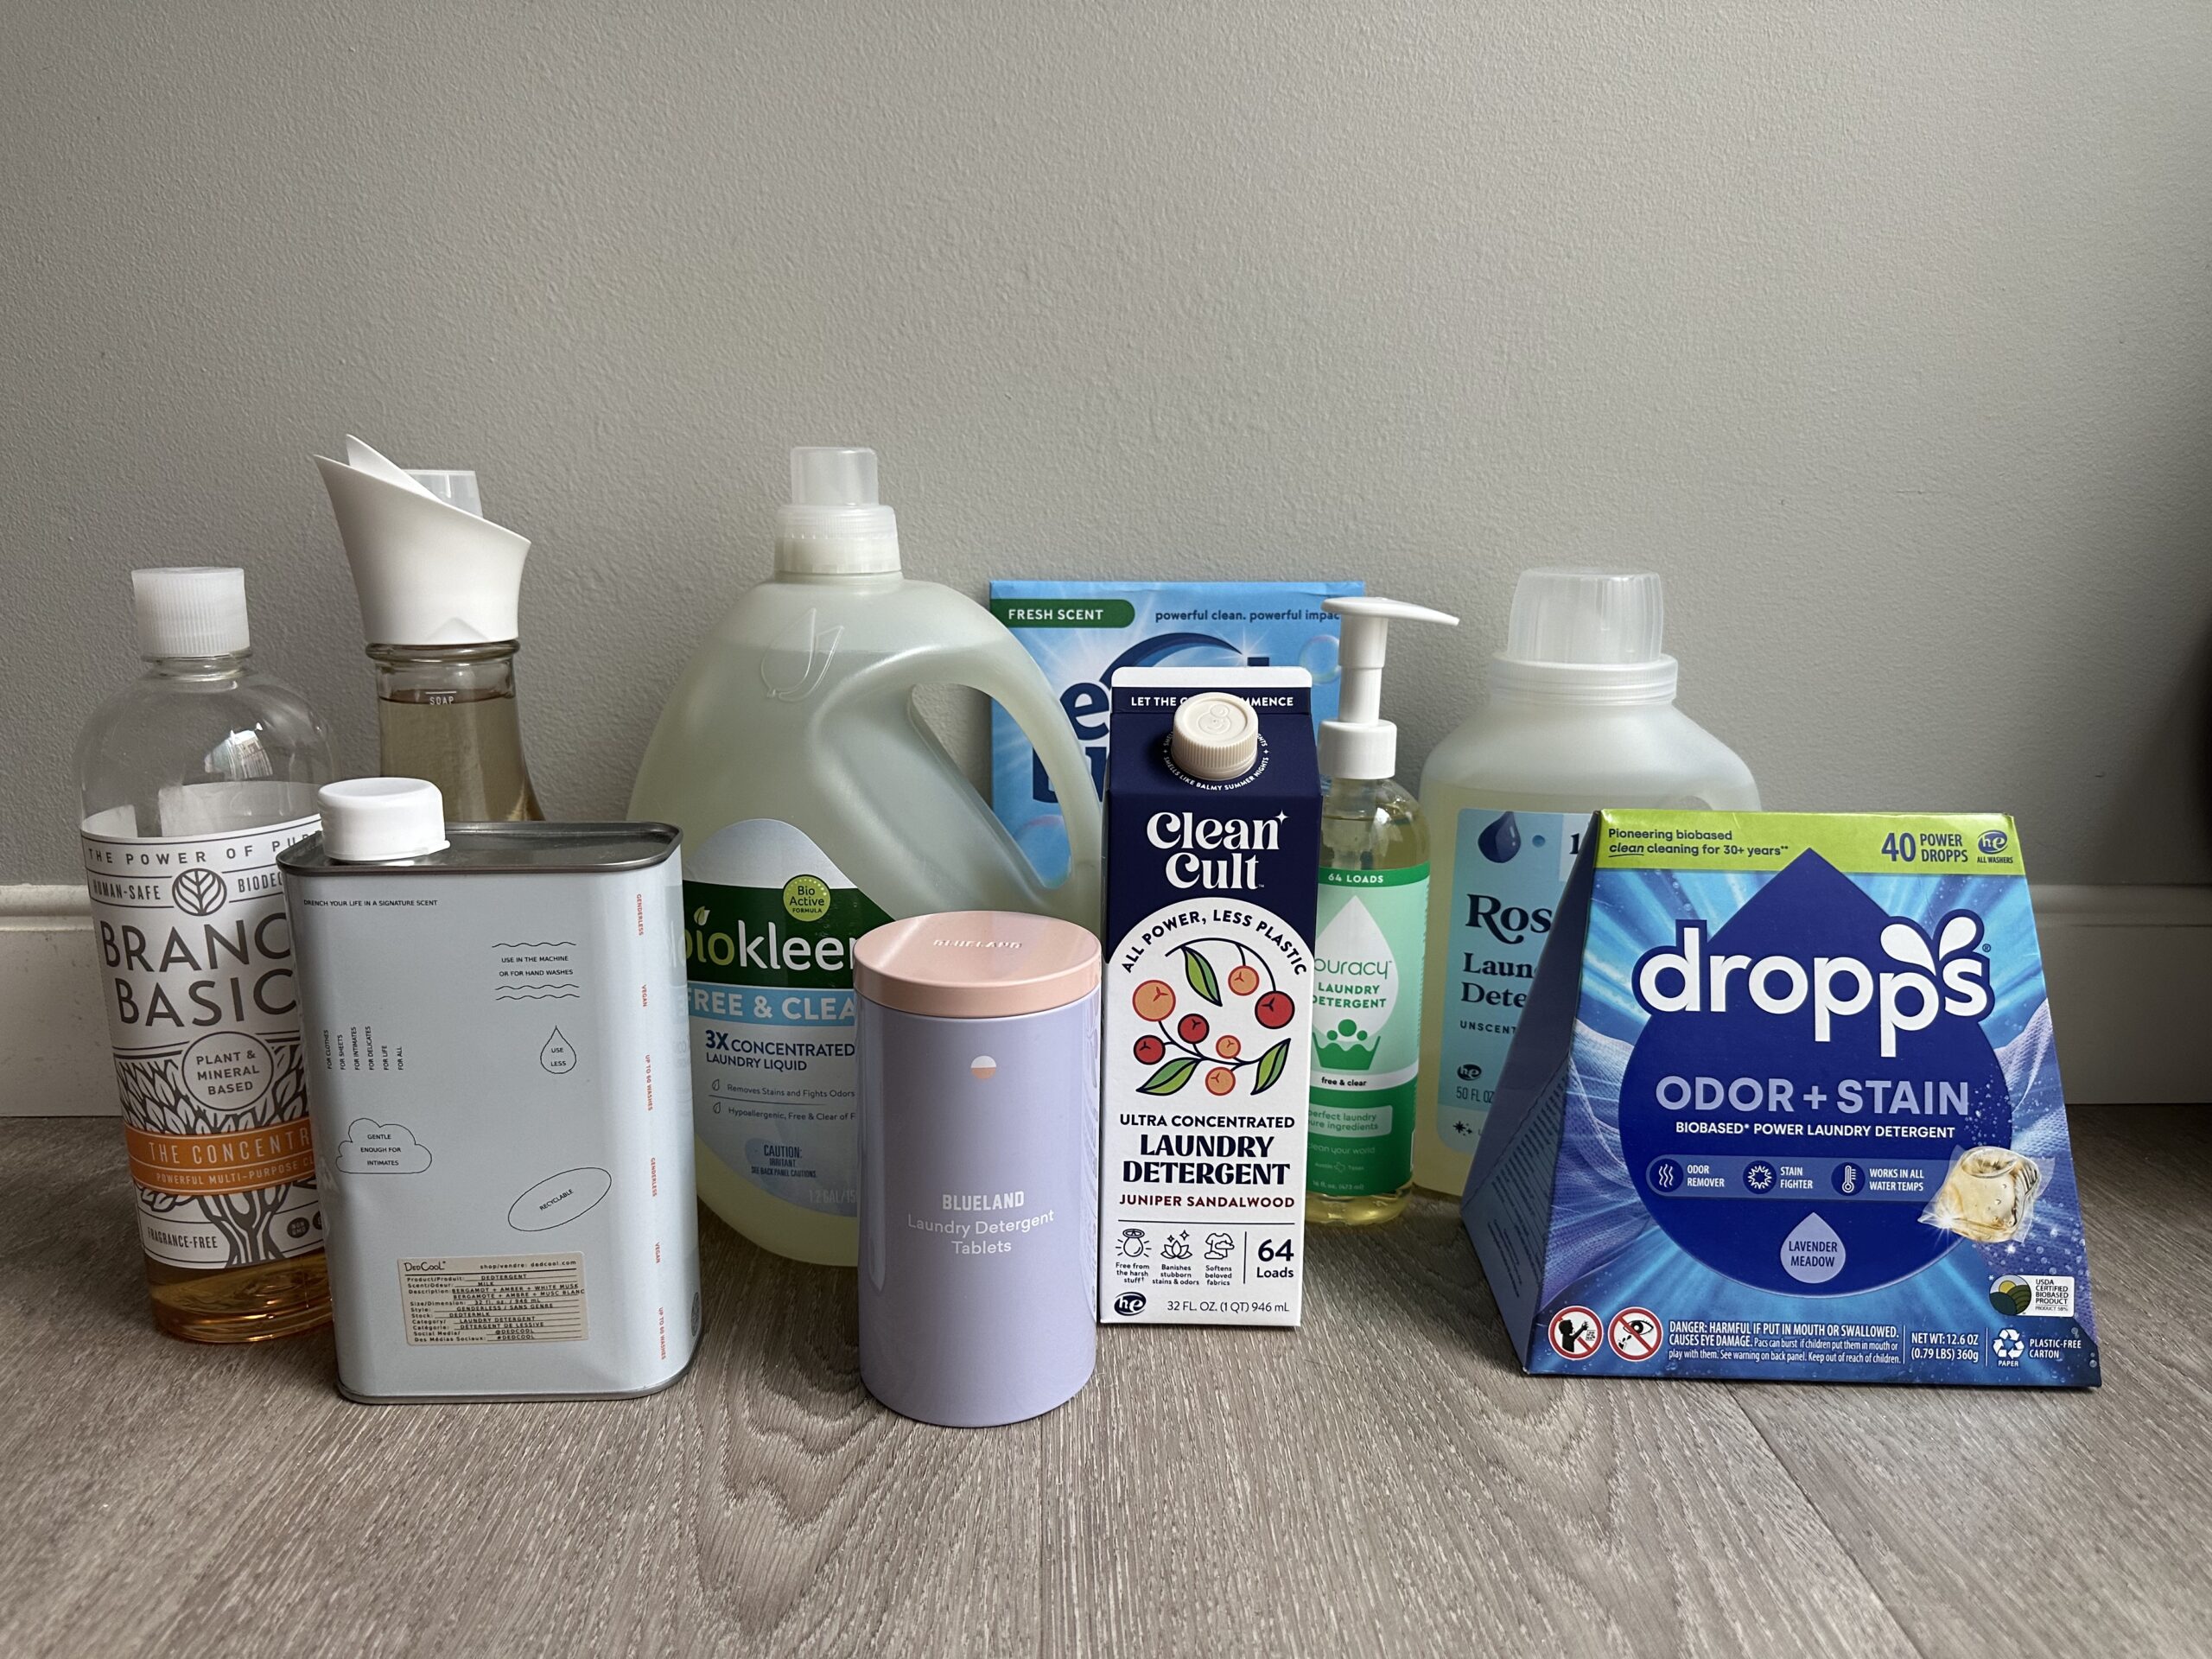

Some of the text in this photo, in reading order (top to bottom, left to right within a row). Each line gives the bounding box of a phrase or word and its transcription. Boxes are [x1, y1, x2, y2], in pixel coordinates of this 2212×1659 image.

[1008, 609, 1104, 620] FRESH SCENT
[1155, 610, 1209, 624] powerful
[1211, 610, 1247, 621] clean.
[1249, 610, 1302, 624] powerful
[429, 696, 454, 706] SOAP
[1131, 696, 1153, 707] LET
[1154, 696, 1177, 707] THE
[1179, 774, 1255, 791] LIKE BALMY SUMMER
[1147, 811, 1280, 850] Clean
[1608, 828, 1732, 842] Pioneering biobased
[1609, 842, 1644, 854] clean
[1647, 843, 1700, 856] cleaning
[1702, 843, 1720, 855] for
[1723, 845, 1745, 855] 30+
[1881, 832, 1962, 862] 40 POWER
[88, 845, 253, 865] THE POWER OF
[1921, 849, 1968, 862] DROPPS
[1166, 852, 1259, 890] Cult
[1327, 873, 1384, 883] 64 LOADS
[93, 879, 162, 900] HUMAN-SAFE
[798, 886, 816, 896] Bio
[789, 897, 825, 906] Active
[1122, 909, 1307, 976] ALL POWER, LESS PLASTIC
[1319, 982, 1380, 995] LAUNDRY
[1639, 926, 1987, 1058] dropps
[753, 995, 773, 1019] &
[705, 1030, 855, 1057] 3X CONCENTRATED
[196, 1049, 257, 1065] PLANT &
[706, 1052, 807, 1072] LAUNDRY LIQUID
[197, 1065, 260, 1081] MINERAL
[207, 1080, 254, 1096] BASED
[1321, 1077, 1338, 1086] free
[1456, 1085, 1468, 1100] 50
[1471, 1089, 1481, 1102] FL
[1656, 1075, 1969, 1116] ODOR + STAIN
[1120, 1113, 1295, 1128] ULTRA CONCENTRATED
[1754, 1123, 1803, 1135] POWER
[1808, 1124, 1871, 1137] LAUNDRY
[1875, 1126, 1955, 1139] DETERGENT
[149, 1141, 181, 1164] THE
[764, 1144, 803, 1159] CAUTION:
[1141, 1134, 1275, 1158] LAUNDRY
[156, 1162, 299, 1185] POWERFUL MULTI-PURPOSE
[1123, 1160, 1291, 1185] DETERGENT
[1687, 1165, 1710, 1175] ODOR
[1780, 1166, 1803, 1177] STAIN
[1870, 1168, 1924, 1179] WORKS ALL
[1687, 1177, 1725, 1188] REMOVER
[1780, 1179, 1814, 1191] FIGHTER
[1870, 1180, 1923, 1192] WATER TEMPS
[539, 1189, 575, 1211] RECYCLABLE
[942, 1191, 1025, 1211] BLUELAND
[1120, 1194, 1295, 1208] JUNIPER SANDALWOOD
[908, 1210, 1055, 1238] Laundry Detergent
[147, 1227, 219, 1249] FRAGRANCE-FREE
[950, 1241, 1012, 1255] Tablets
[1258, 1238, 1294, 1262] 64
[1789, 1241, 1838, 1254] LAVENDER
[1790, 1255, 1835, 1268] MEADOW
[1256, 1267, 1294, 1279] Loads
[1166, 1301, 1290, 1313] 32 FL. OZ. (1 QT) 946 mL
[1669, 1320, 1899, 1338] DANGER: HARMFUL PUT IN MOUTH OR SWALLOWED.
[1669, 1333, 1753, 1347] CAUSES EYE DAMAGE.
[1911, 1332, 1928, 1344] NET
[1947, 1334, 1966, 1345] 12.6
[1967, 1334, 1979, 1345] OZ
[2029, 1338, 2082, 1349] PLASTIC-FREE
[1911, 1348, 1979, 1363] (0.79 LBS) 360g
[2029, 1350, 2060, 1359] CARTON
